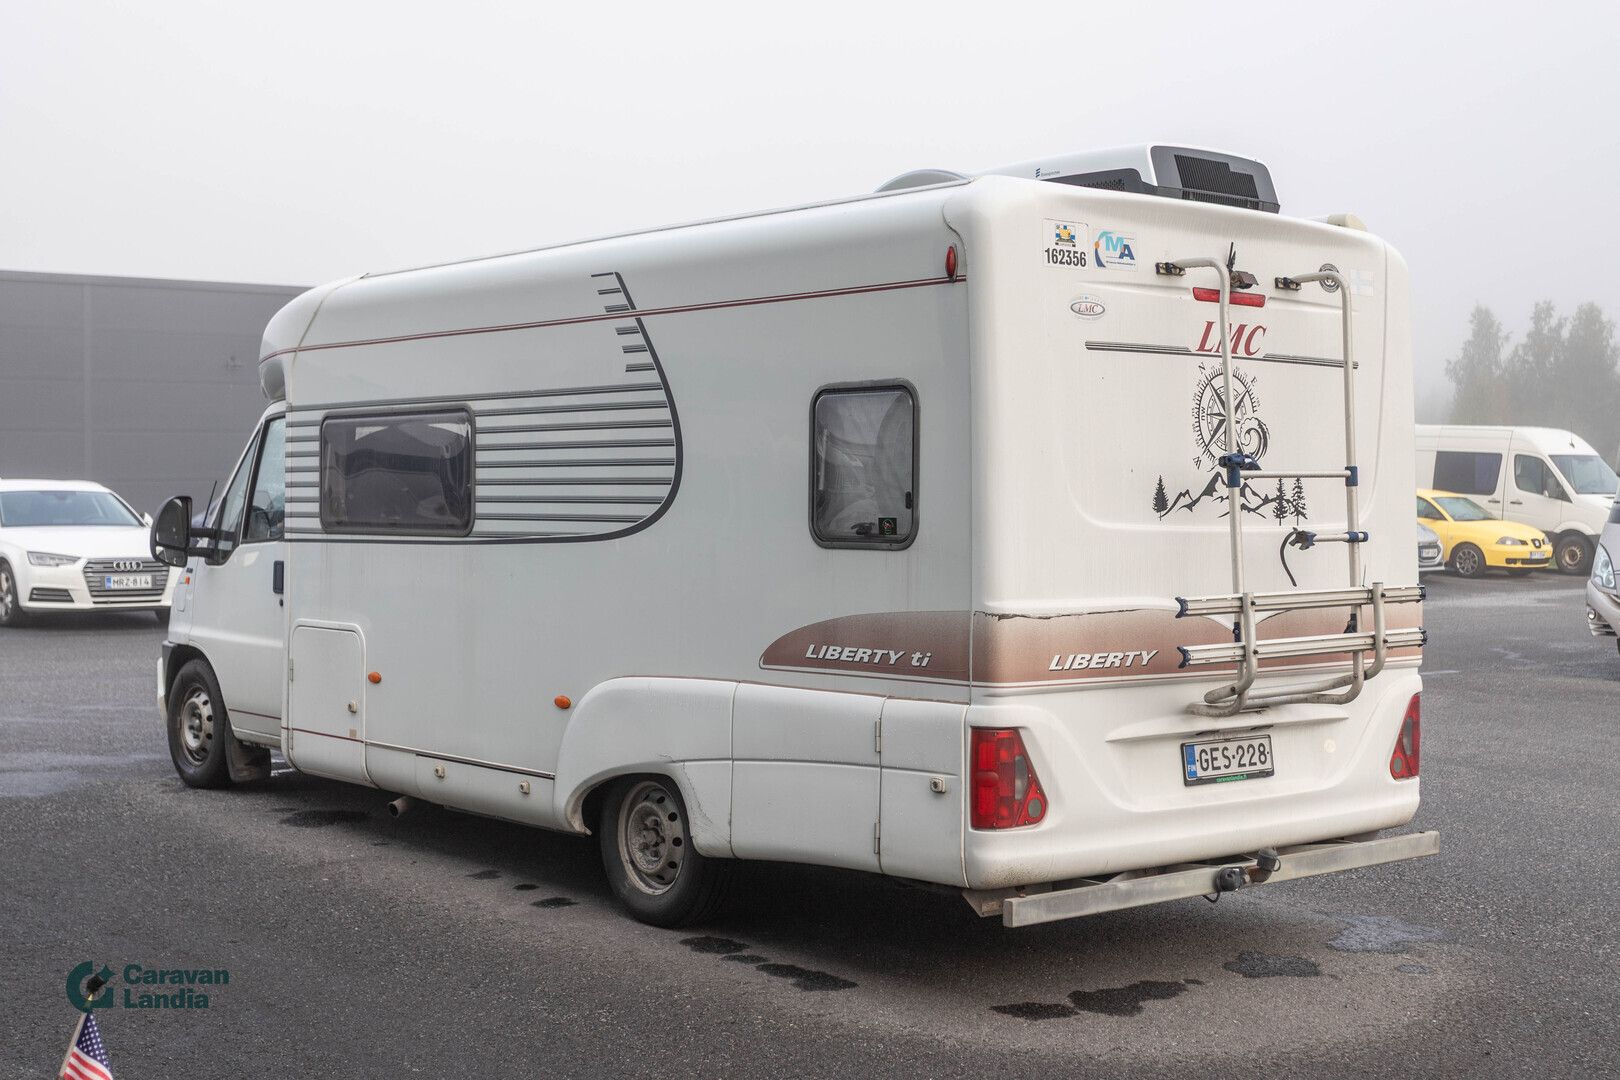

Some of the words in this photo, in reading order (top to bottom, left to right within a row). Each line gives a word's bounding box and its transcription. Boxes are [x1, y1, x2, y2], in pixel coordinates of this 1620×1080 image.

[1045, 248, 1086, 267] 162356
[1105, 235, 1135, 260] MA
[1078, 303, 1098, 313] LMC
[1196, 320, 1267, 356] LMC
[113, 577, 150, 587] MRZ-814
[805, 644, 905, 665] LIBERTY
[911, 651, 931, 667] ti
[1049, 649, 1159, 671] LIBERTY
[1199, 742, 1267, 772] GES-228
